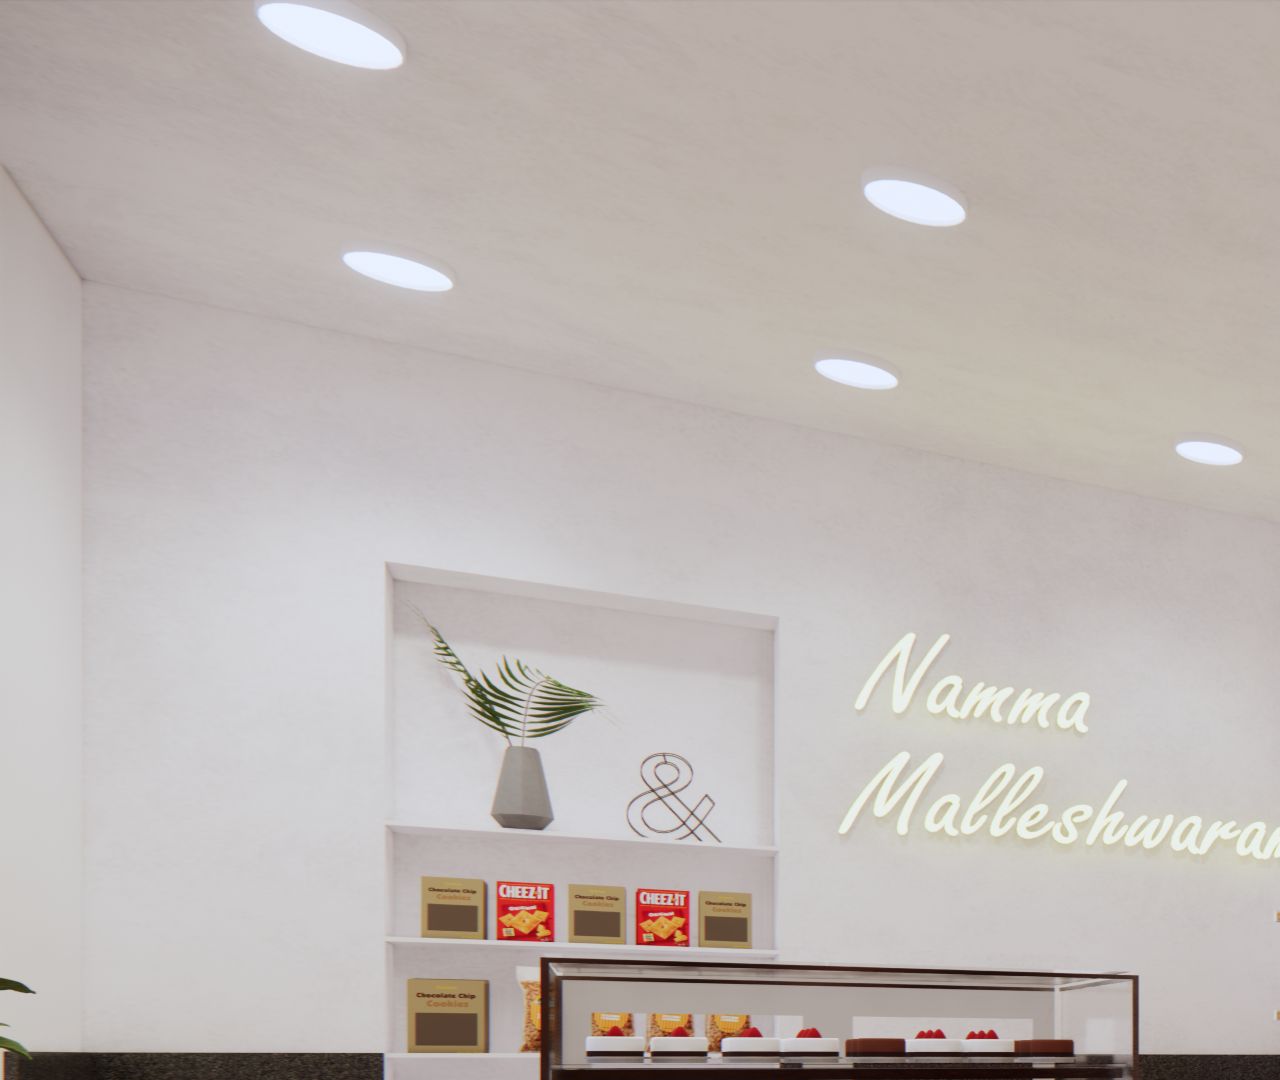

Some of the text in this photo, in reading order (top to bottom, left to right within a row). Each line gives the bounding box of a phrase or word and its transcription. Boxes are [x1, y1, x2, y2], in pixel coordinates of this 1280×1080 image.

[854, 632, 1091, 733] Namma
[498, 884, 550, 900] CHEEZ-IT
[639, 891, 687, 906] CHEEZ-IT
